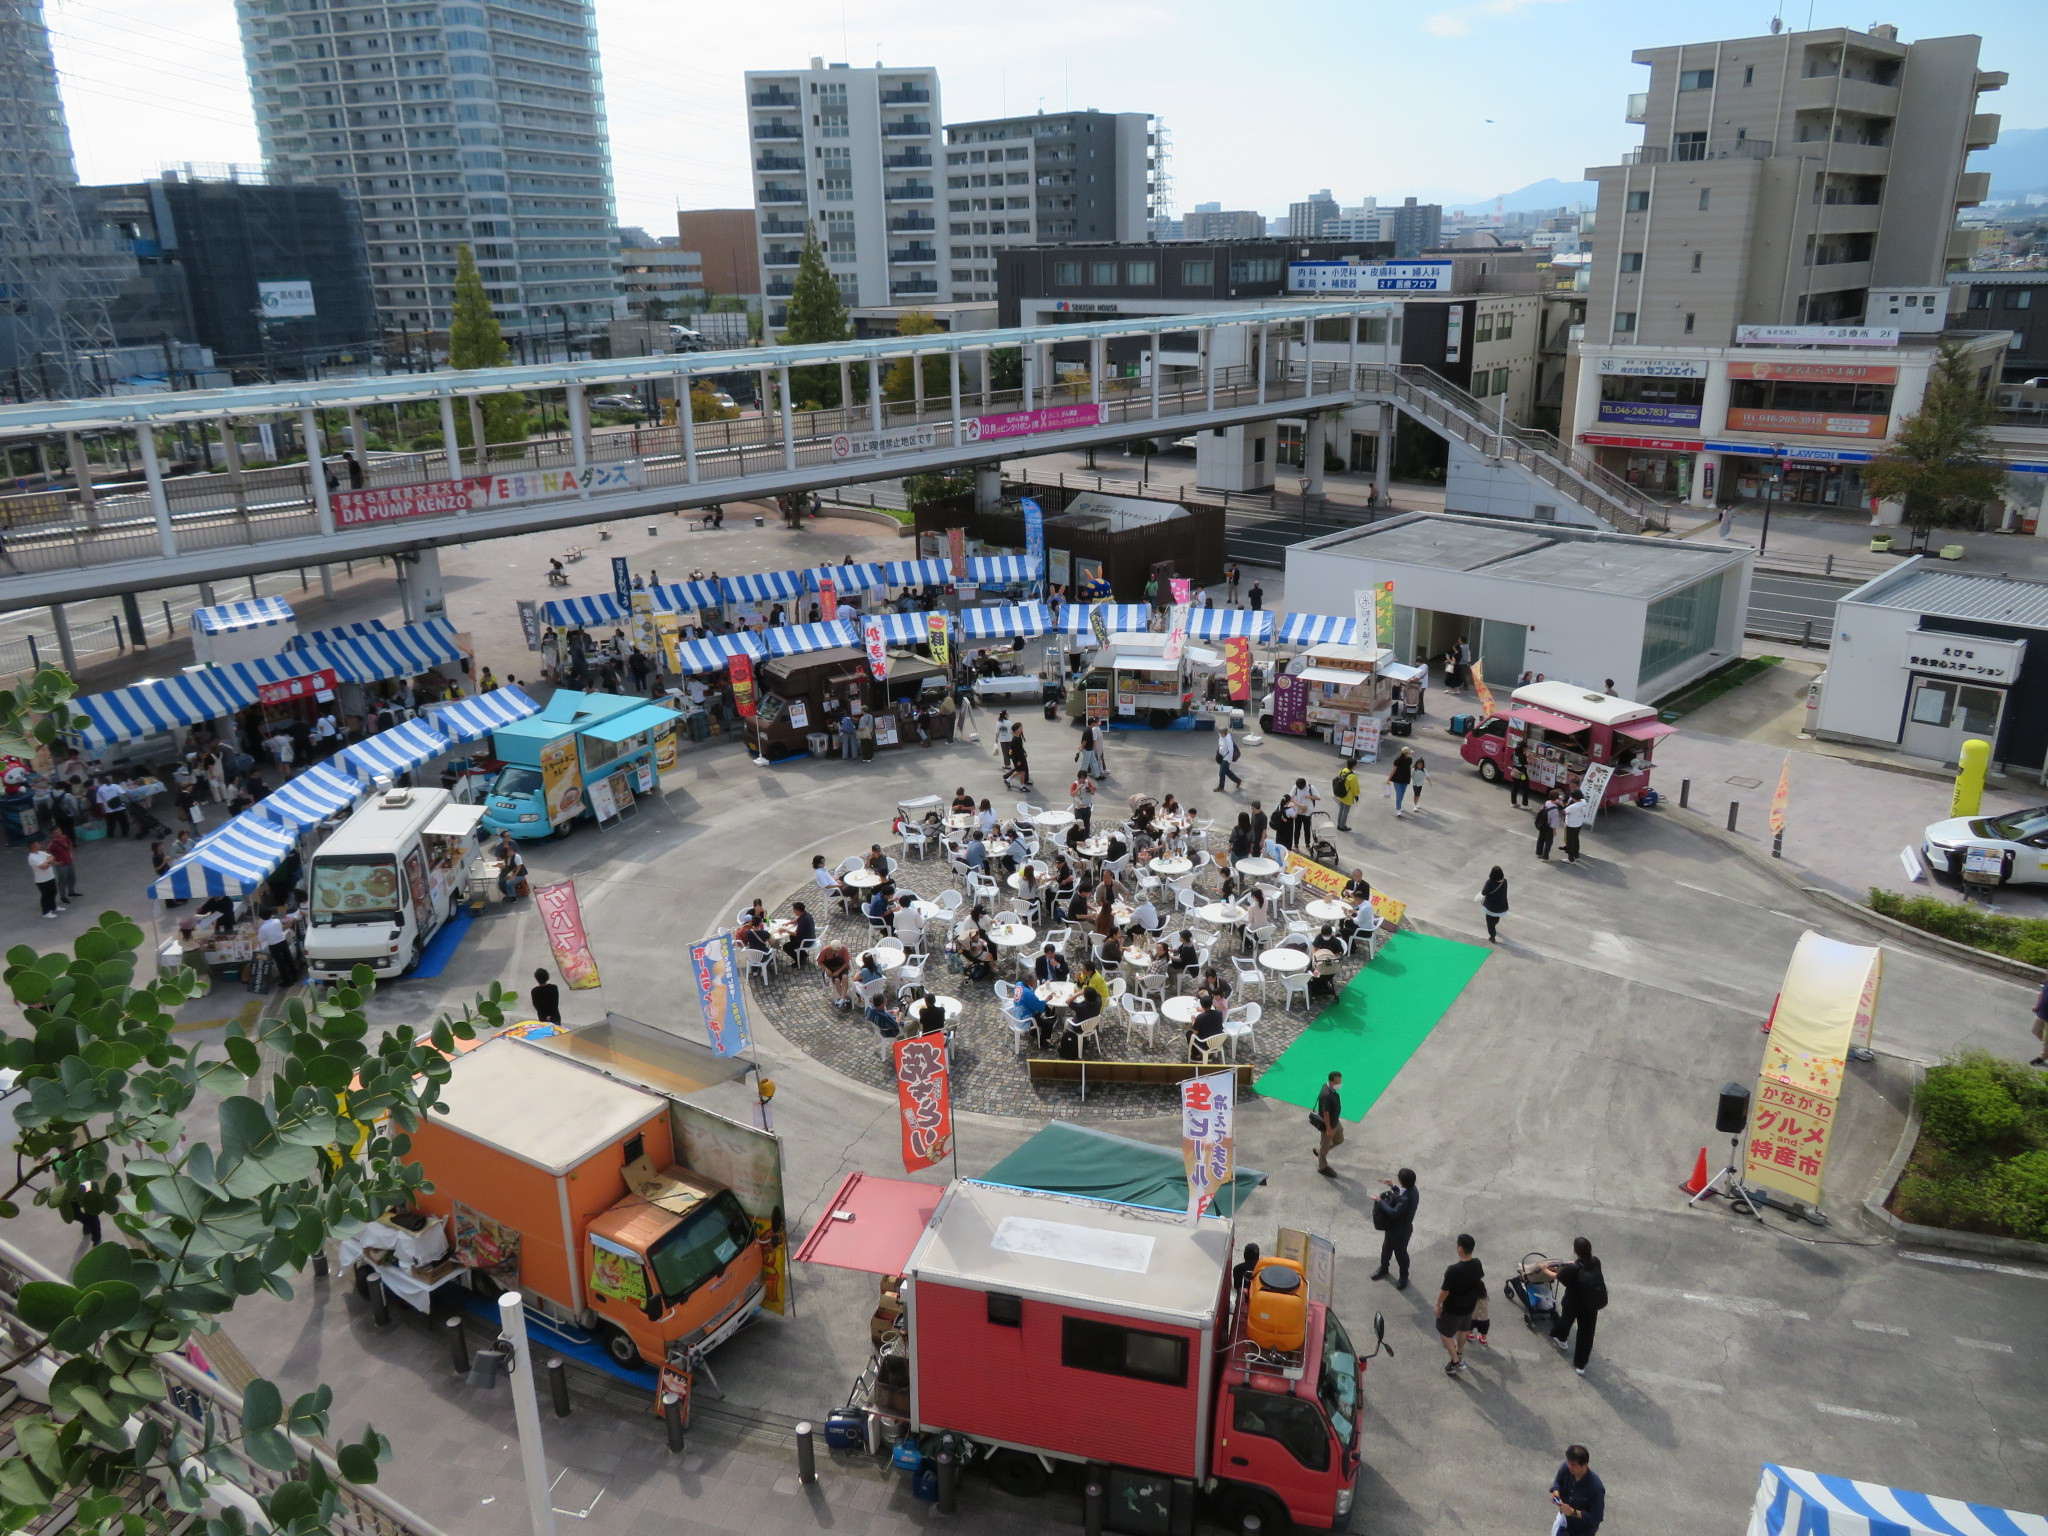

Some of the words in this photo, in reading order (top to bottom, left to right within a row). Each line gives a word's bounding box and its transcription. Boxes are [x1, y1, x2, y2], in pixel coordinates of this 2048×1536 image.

[1098, 304, 1117, 312] HOUSE
[1880, 330, 1893, 338] 2F
[851, 433, 933, 454] 路上喫煙禁止地区です
[1789, 449, 1835, 459] LAWSON
[343, 508, 365, 523] DA
[368, 501, 413, 520] PUMP
[416, 495, 467, 513] KENZO
[1942, 647, 1974, 659] えびな
[1910, 656, 2005, 676] 安全安心ステーション
[1314, 869, 1340, 886] グルメ
[1762, 1086, 1832, 1117] かながわ
[1757, 1110, 1825, 1144] グルメ
[1777, 1135, 1798, 1147] and
[1750, 1139, 1821, 1176] 特産市
